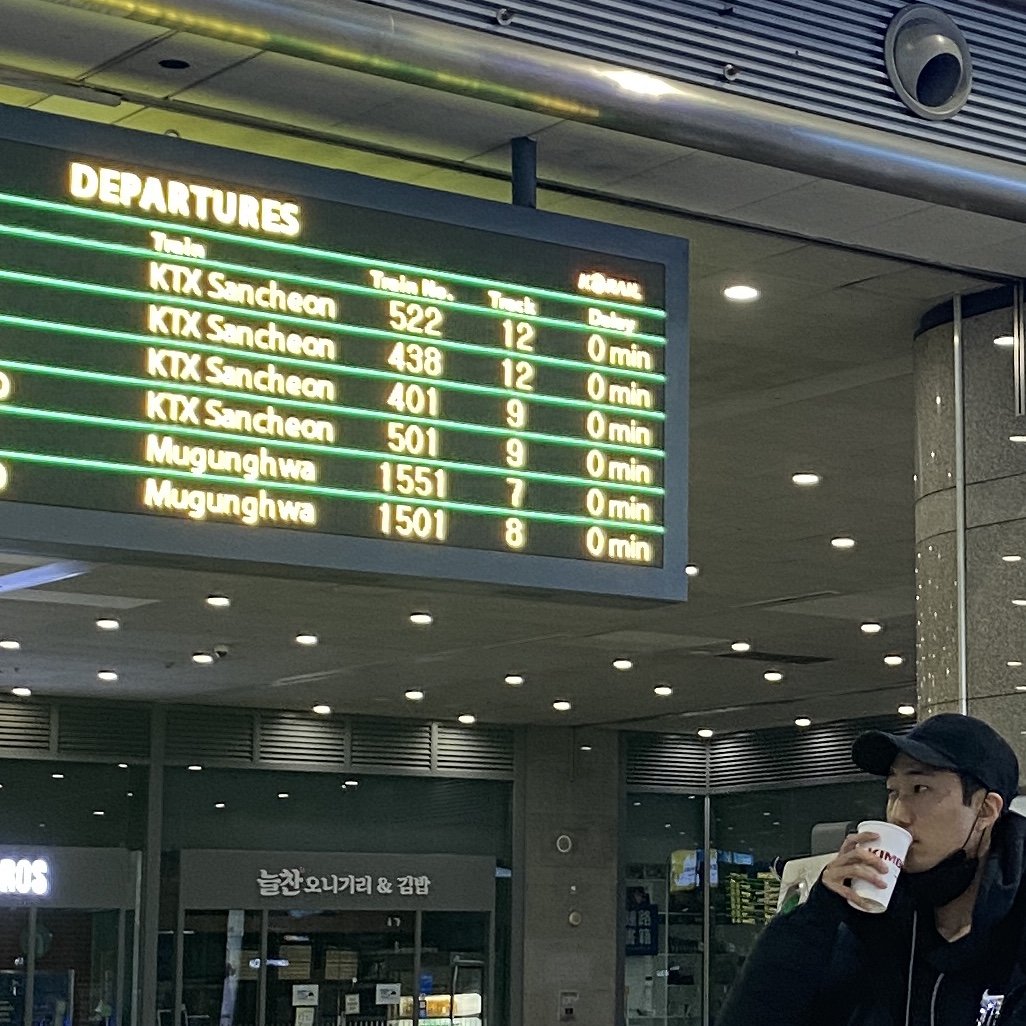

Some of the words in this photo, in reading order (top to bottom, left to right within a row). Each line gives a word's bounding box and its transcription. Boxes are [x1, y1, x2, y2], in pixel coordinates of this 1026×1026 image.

[69, 162, 301, 237] DEPARTURES
[150, 231, 206, 259] Train
[369, 269, 419, 296] Train
[149, 304, 201, 339] KTX
[206, 314, 336, 360] Sancheon
[387, 342, 442, 377] 438
[502, 358, 534, 391] 12
[587, 372, 605, 400] 0
[609, 380, 651, 408] min
[150, 262, 202, 296] KTX
[207, 271, 337, 319] Sancheon
[389, 300, 444, 337] 522
[502, 319, 535, 352] 12
[587, 333, 606, 362] 0
[609, 343, 652, 370] min
[147, 347, 201, 382] KTX
[205, 356, 335, 401] Sancheon
[387, 382, 439, 416] 401
[506, 398, 525, 429] 9
[587, 410, 605, 439] 0
[608, 418, 651, 446] min
[147, 390, 200, 425] KTX
[204, 399, 334, 443] Sancheon
[387, 421, 439, 457] 501
[506, 437, 525, 469] 9
[586, 449, 604, 478] 0
[608, 457, 651, 484] min
[144, 478, 316, 526] Mugunghwa
[379, 502, 446, 541] 1501
[505, 517, 525, 548] 8
[586, 526, 605, 556] 0
[608, 533, 651, 562] min
[146, 433, 317, 482] Mugunghwa
[380, 461, 447, 498] 1551
[506, 477, 524, 508] 7
[586, 488, 605, 517] 0
[608, 495, 651, 522] min
[304, 874, 372, 895] 오니기리
[376, 876, 393, 895] &
[397, 875, 431, 896] 김밥
